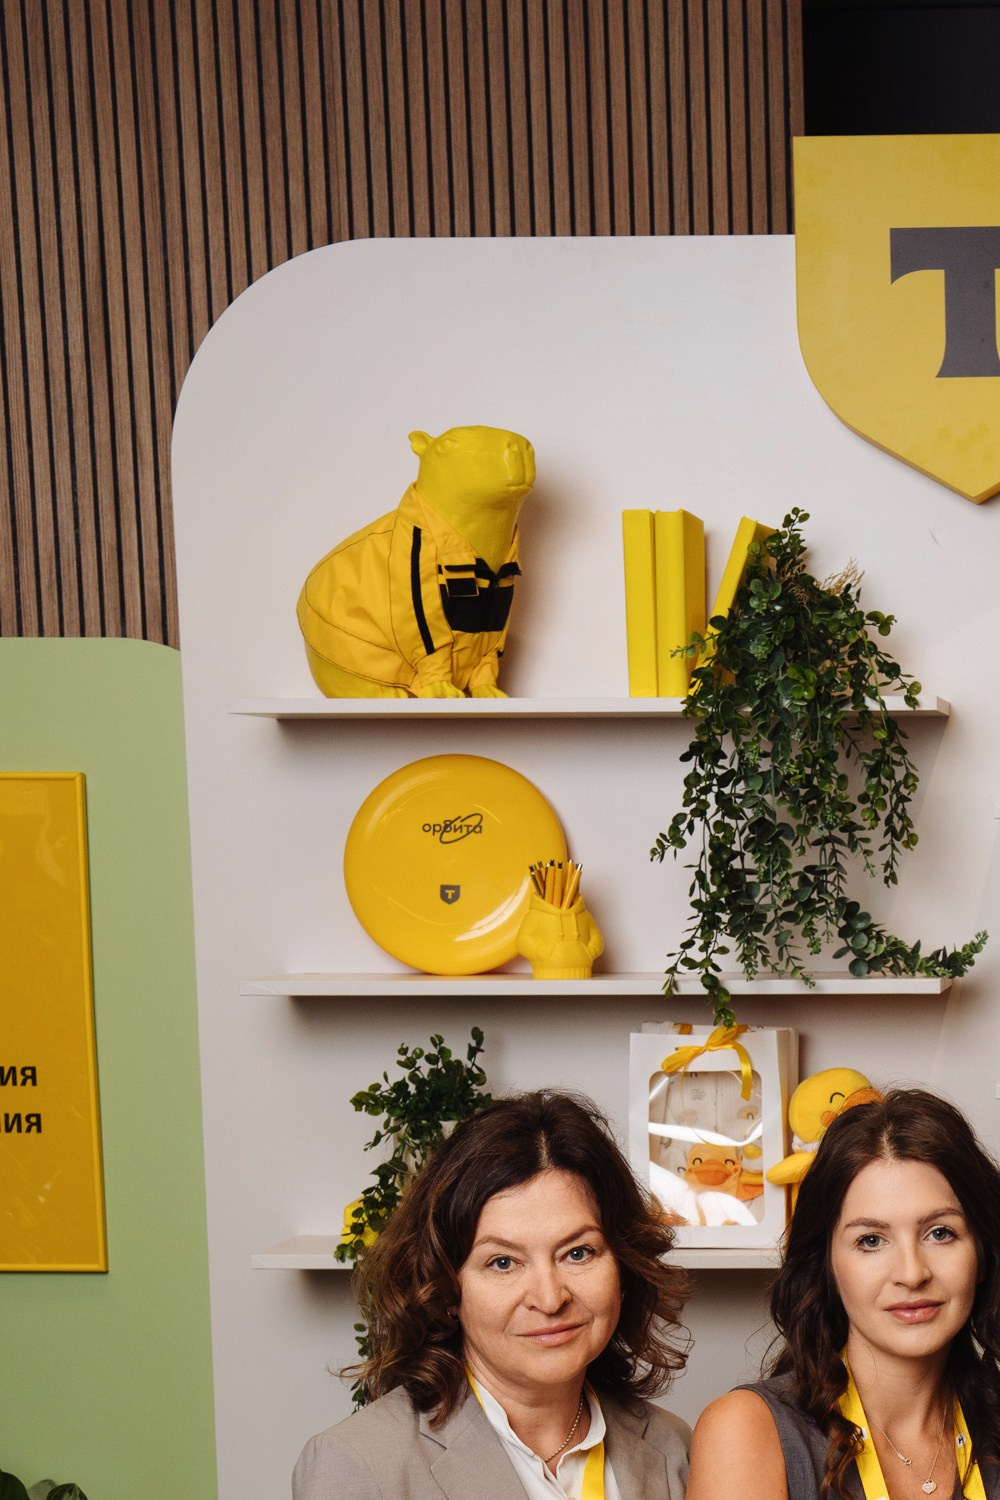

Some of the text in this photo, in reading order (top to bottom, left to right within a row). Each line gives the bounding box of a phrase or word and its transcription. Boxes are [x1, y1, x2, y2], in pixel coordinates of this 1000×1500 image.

[422, 816, 483, 837] орбита
[445, 889, 456, 900] Т
[0, 1112, 42, 1134] ия
